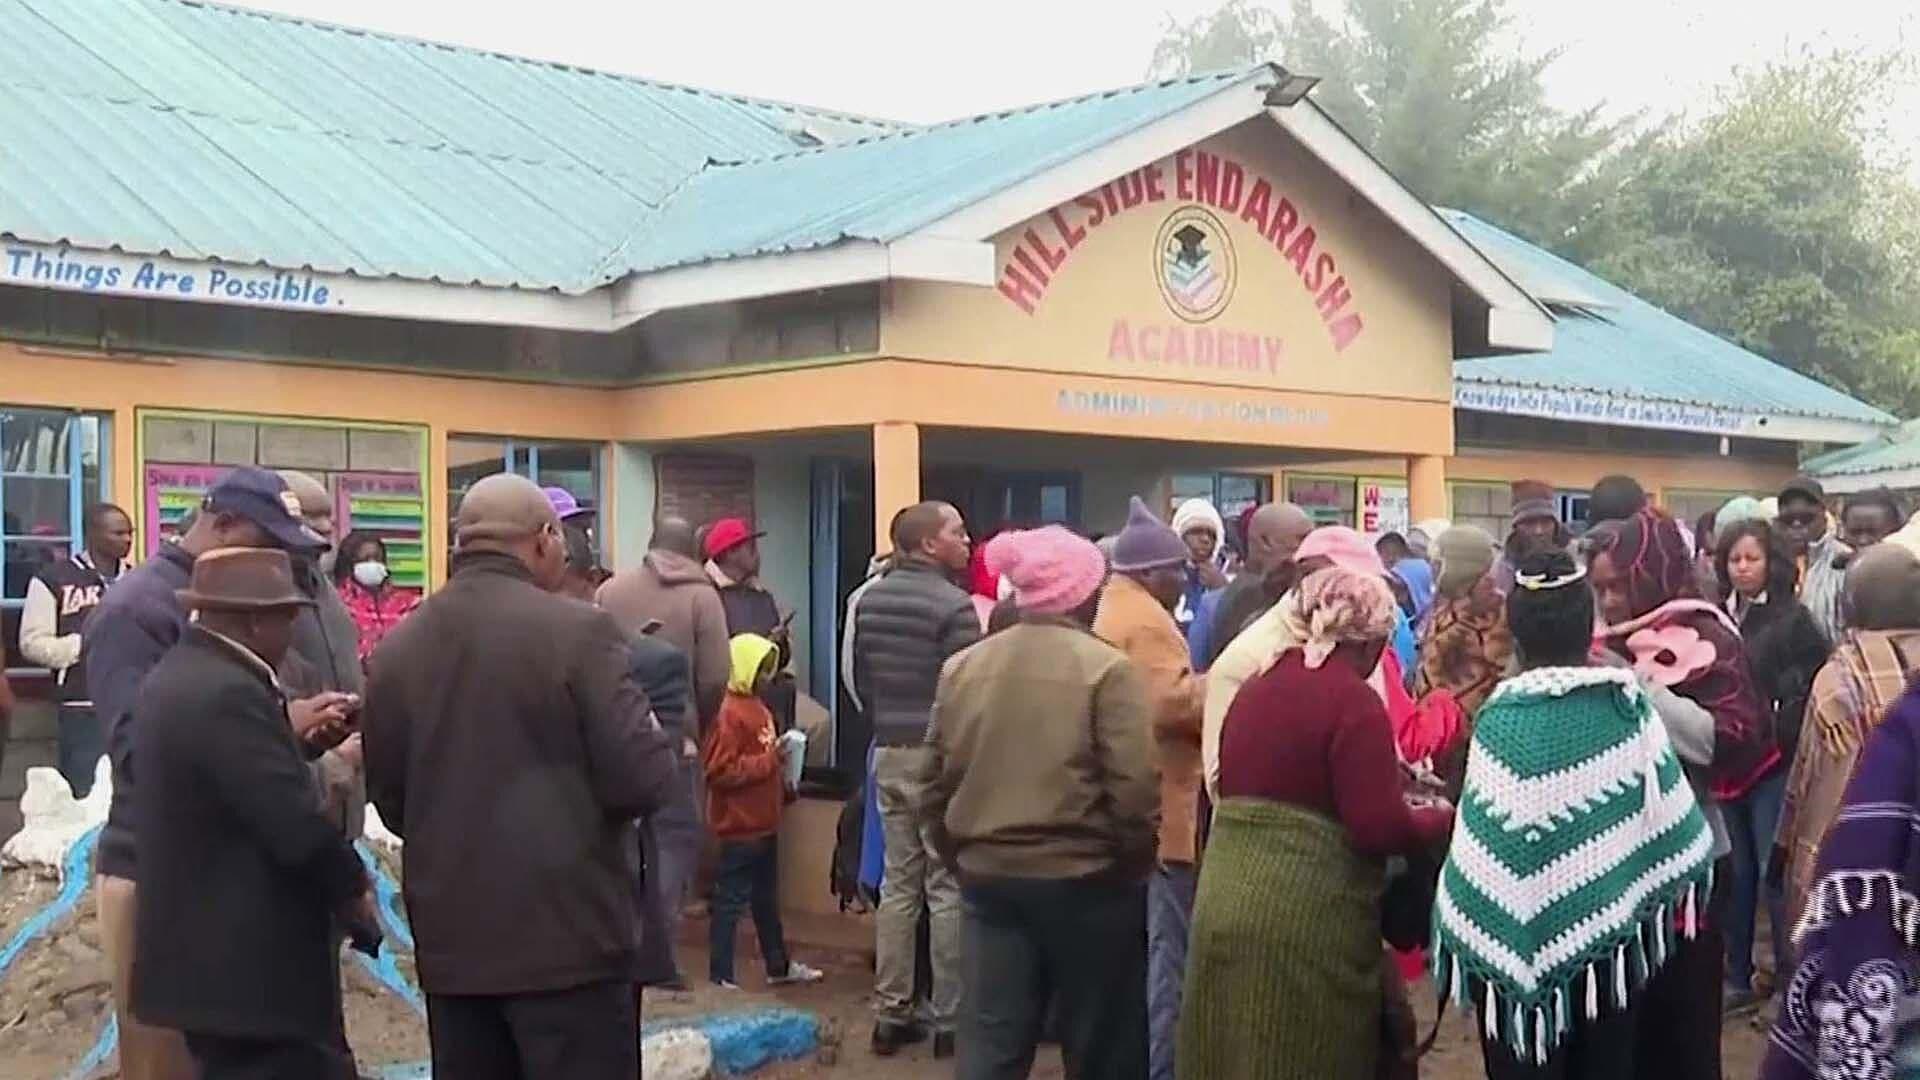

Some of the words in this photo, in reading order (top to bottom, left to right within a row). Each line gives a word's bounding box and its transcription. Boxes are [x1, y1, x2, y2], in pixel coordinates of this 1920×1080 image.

[7, 246, 121, 289] Things
[132, 262, 195, 293] Are
[1175, 150, 1363, 352] ENDARASHA
[1106, 317, 1283, 375] ACADEMY
